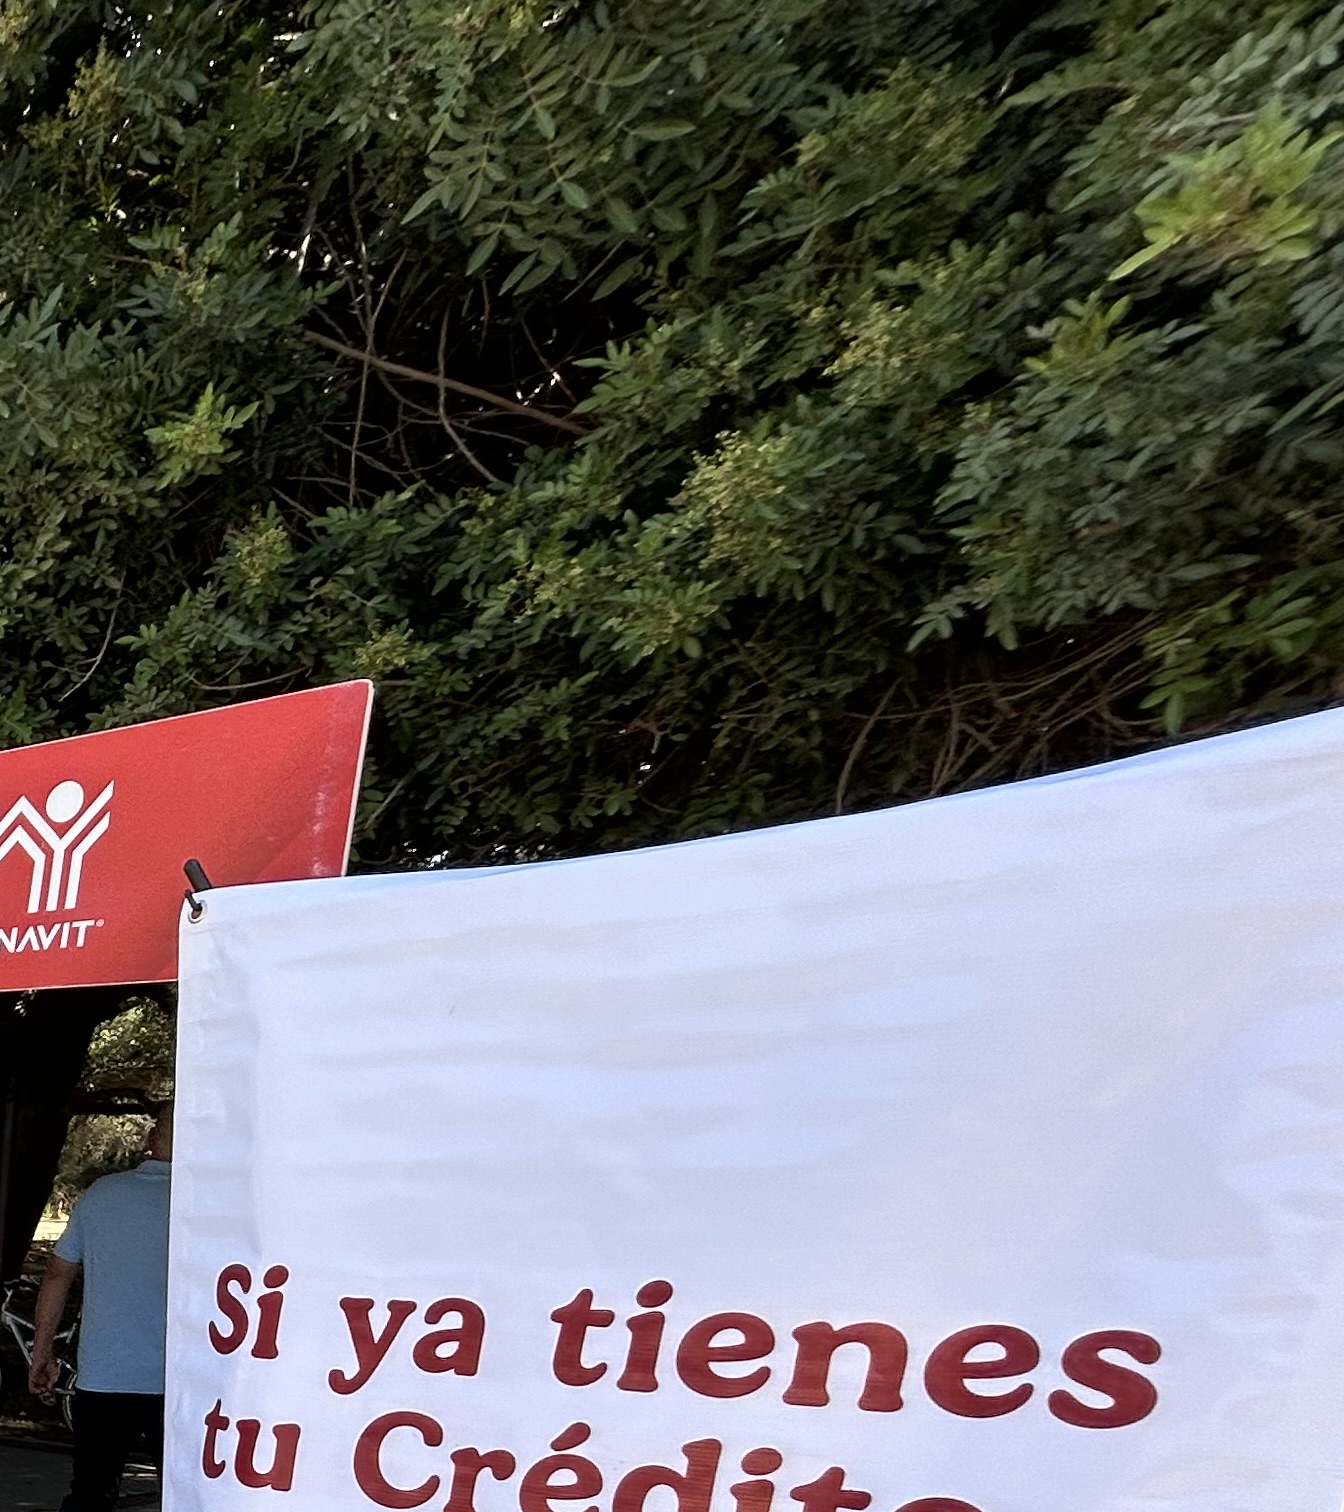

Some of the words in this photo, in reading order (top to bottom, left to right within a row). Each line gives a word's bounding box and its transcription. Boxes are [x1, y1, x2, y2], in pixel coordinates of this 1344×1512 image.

[208, 1263, 289, 1359] Si
[328, 1296, 487, 1394] ya
[550, 1279, 1162, 1429] tienes
[202, 1400, 299, 1492] tu
